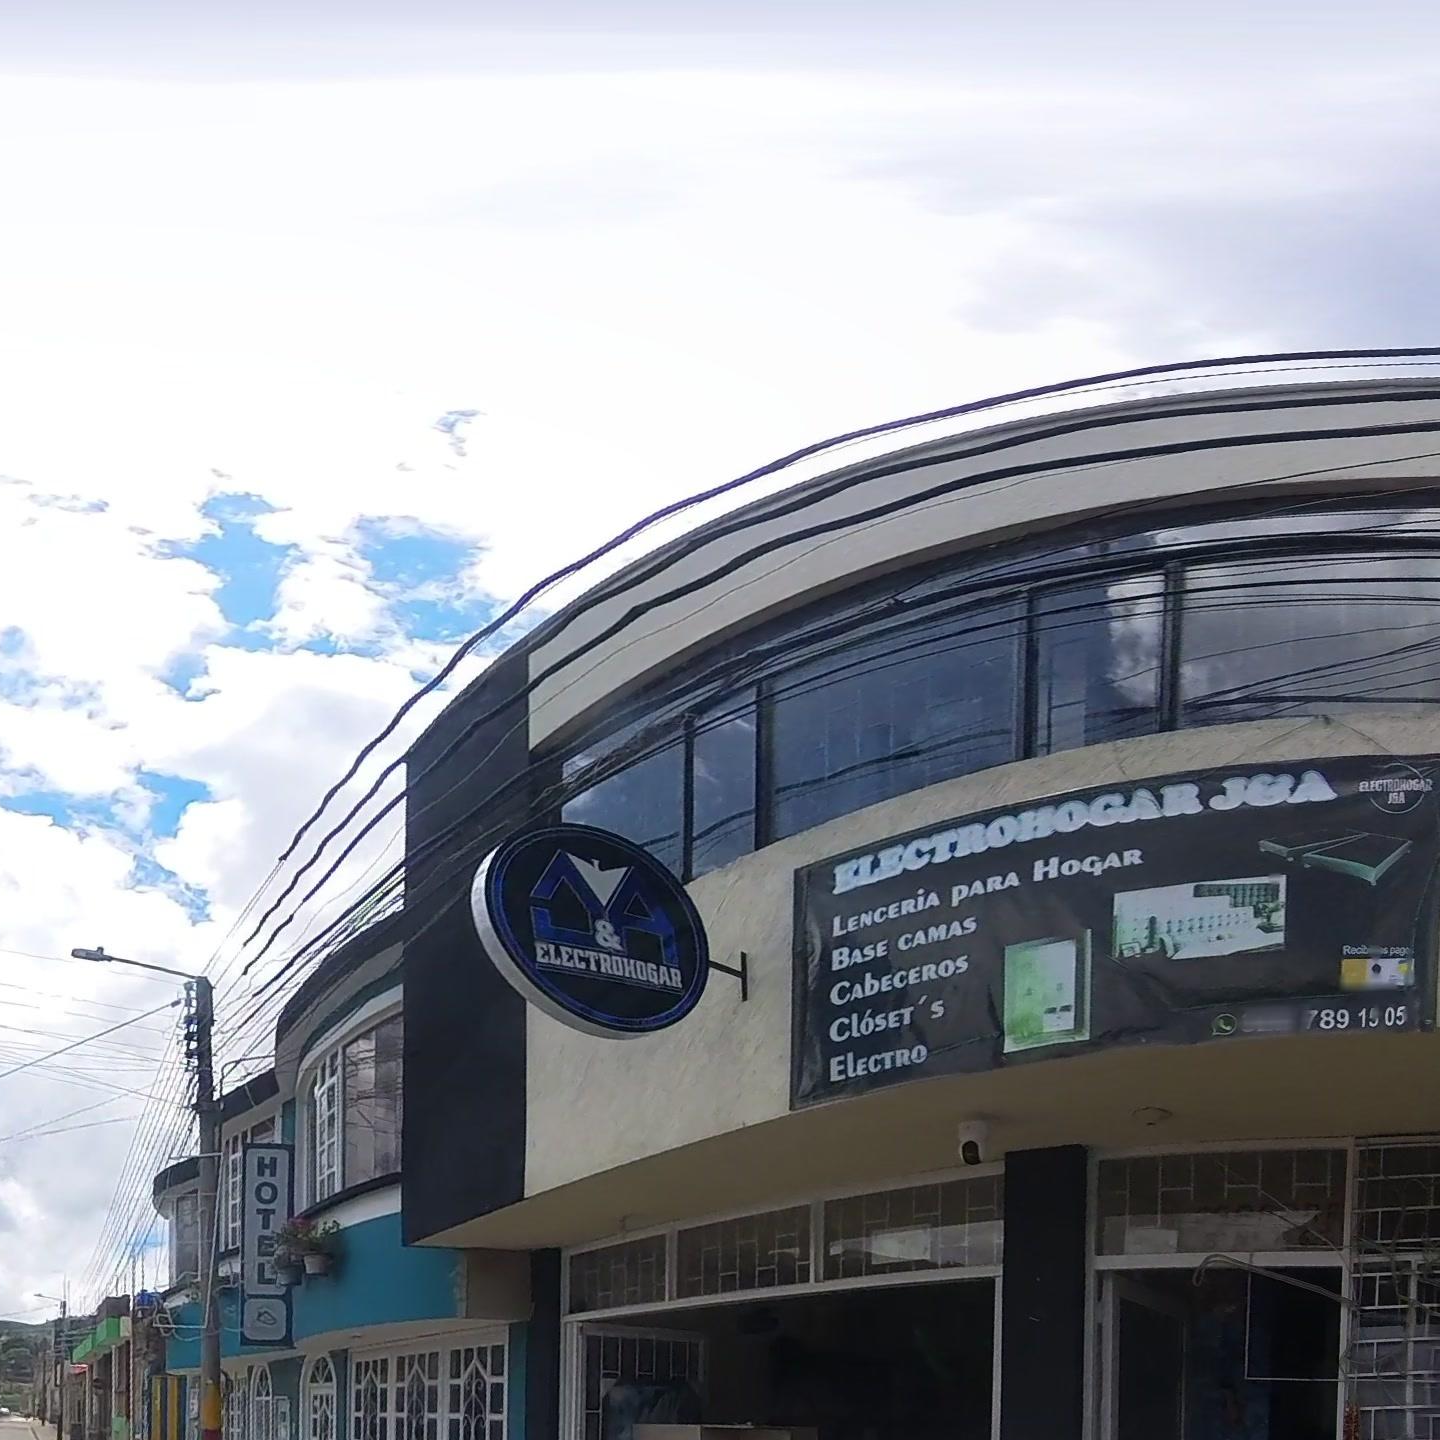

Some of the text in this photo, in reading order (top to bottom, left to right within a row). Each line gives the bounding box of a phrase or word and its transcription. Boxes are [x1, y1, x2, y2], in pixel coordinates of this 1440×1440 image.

[1358, 777, 1433, 794] ELECTROHOGAR
[831, 783, 1204, 895] ELECTROHOGAR
[534, 940, 684, 990] ELECTROHOGAR
[1384, 1006, 1407, 1026] 05
[254, 1156, 278, 1285] HOTEL
